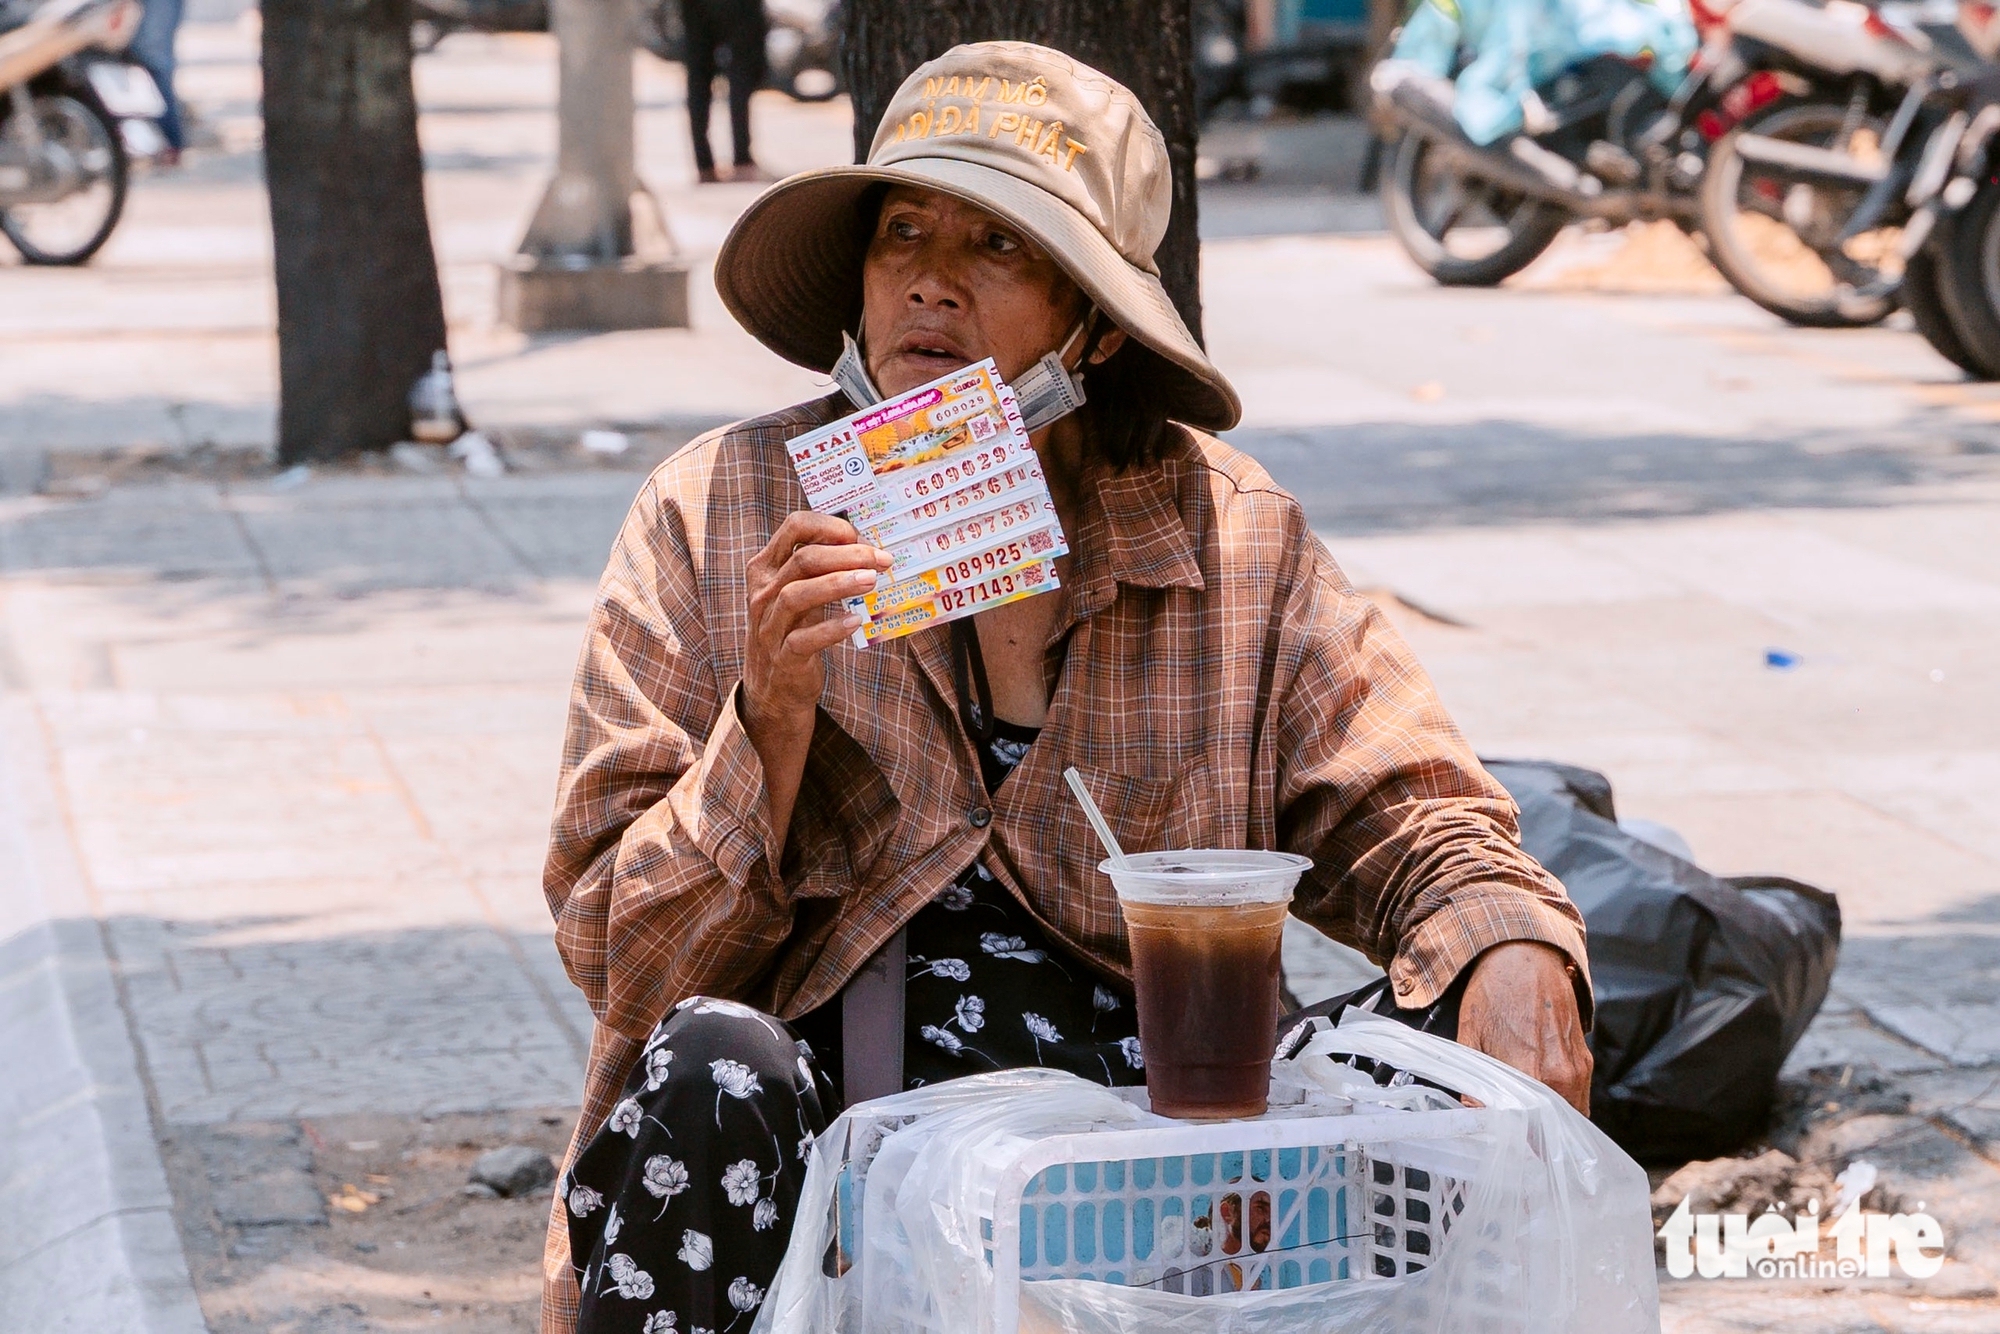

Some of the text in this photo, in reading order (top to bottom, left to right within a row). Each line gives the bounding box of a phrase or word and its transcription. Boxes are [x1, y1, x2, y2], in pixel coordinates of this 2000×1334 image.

[923, 75, 1047, 106] NAM MÔ
[988, 112, 1087, 172] PHẬT
[936, 395, 985, 421] 609029
[916, 446, 1006, 496] 609029
[936, 503, 1030, 551] 049753
[945, 543, 1021, 583] 089925
[873, 586, 935, 611] 07-04-2026
[941, 575, 1014, 611] 027143
[870, 612, 930, 634] 07-04-2026
